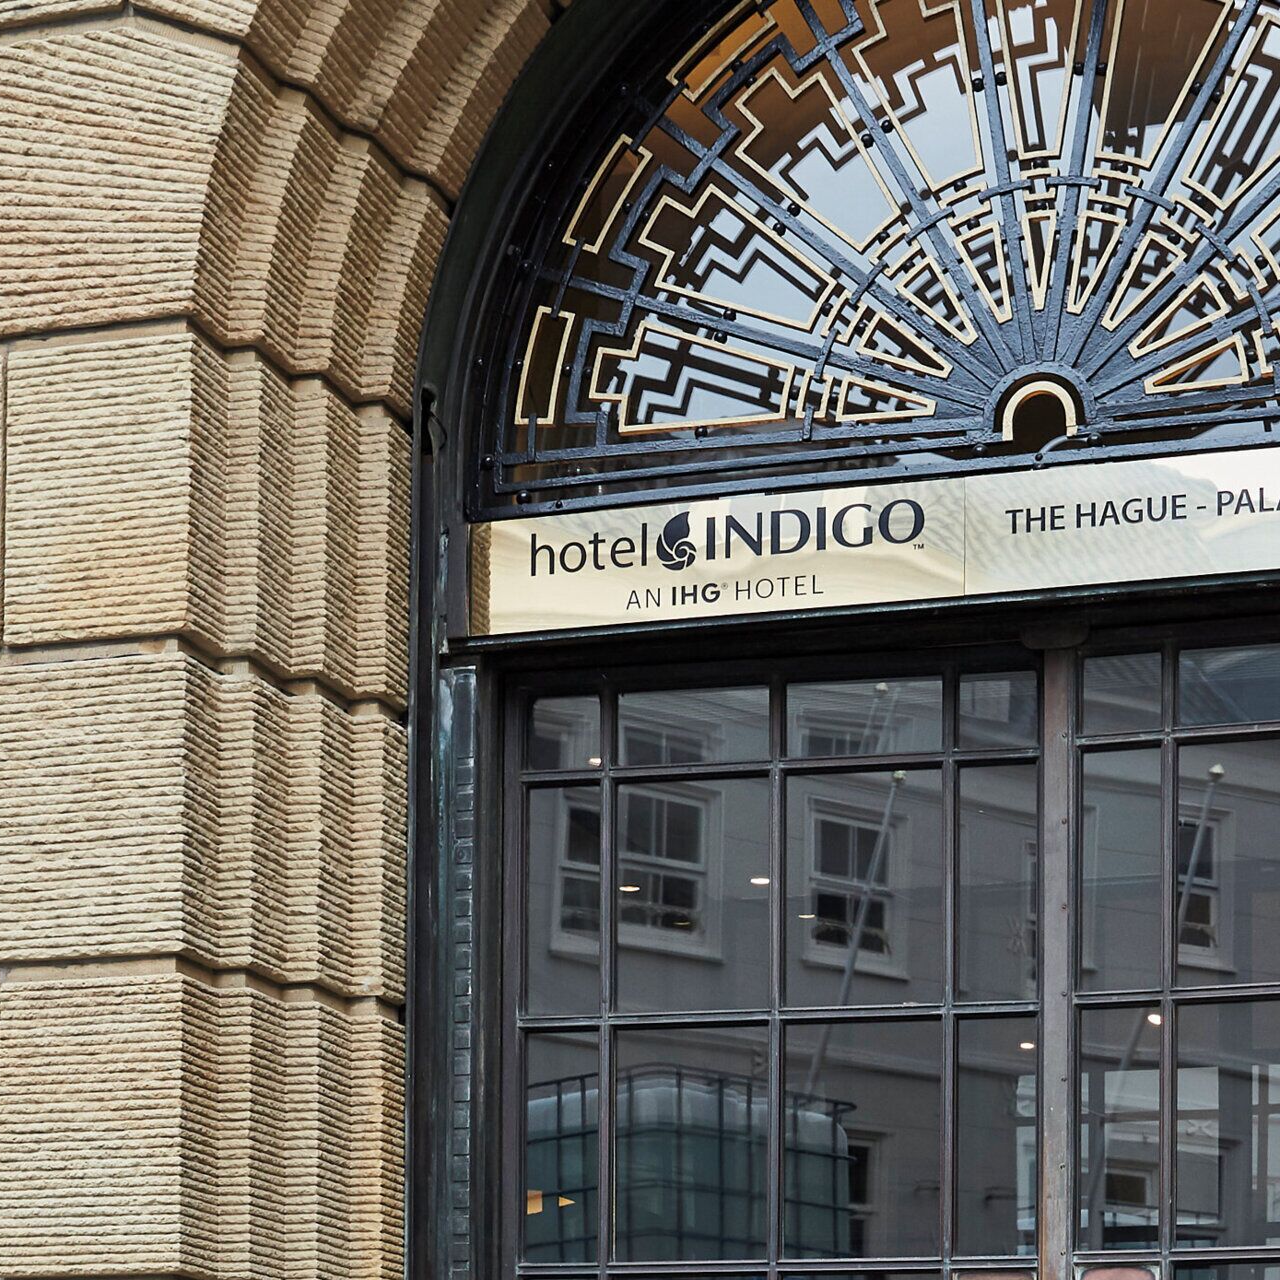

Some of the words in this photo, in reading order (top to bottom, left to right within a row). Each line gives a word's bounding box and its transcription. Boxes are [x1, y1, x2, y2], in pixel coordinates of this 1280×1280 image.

[1005, 505, 1066, 535] THE
[1075, 493, 1188, 529] HAGUE
[530, 522, 648, 577] hotel
[705, 498, 926, 561] INDIGO
[626, 588, 662, 611] AN
[735, 574, 825, 601] HOTEL
